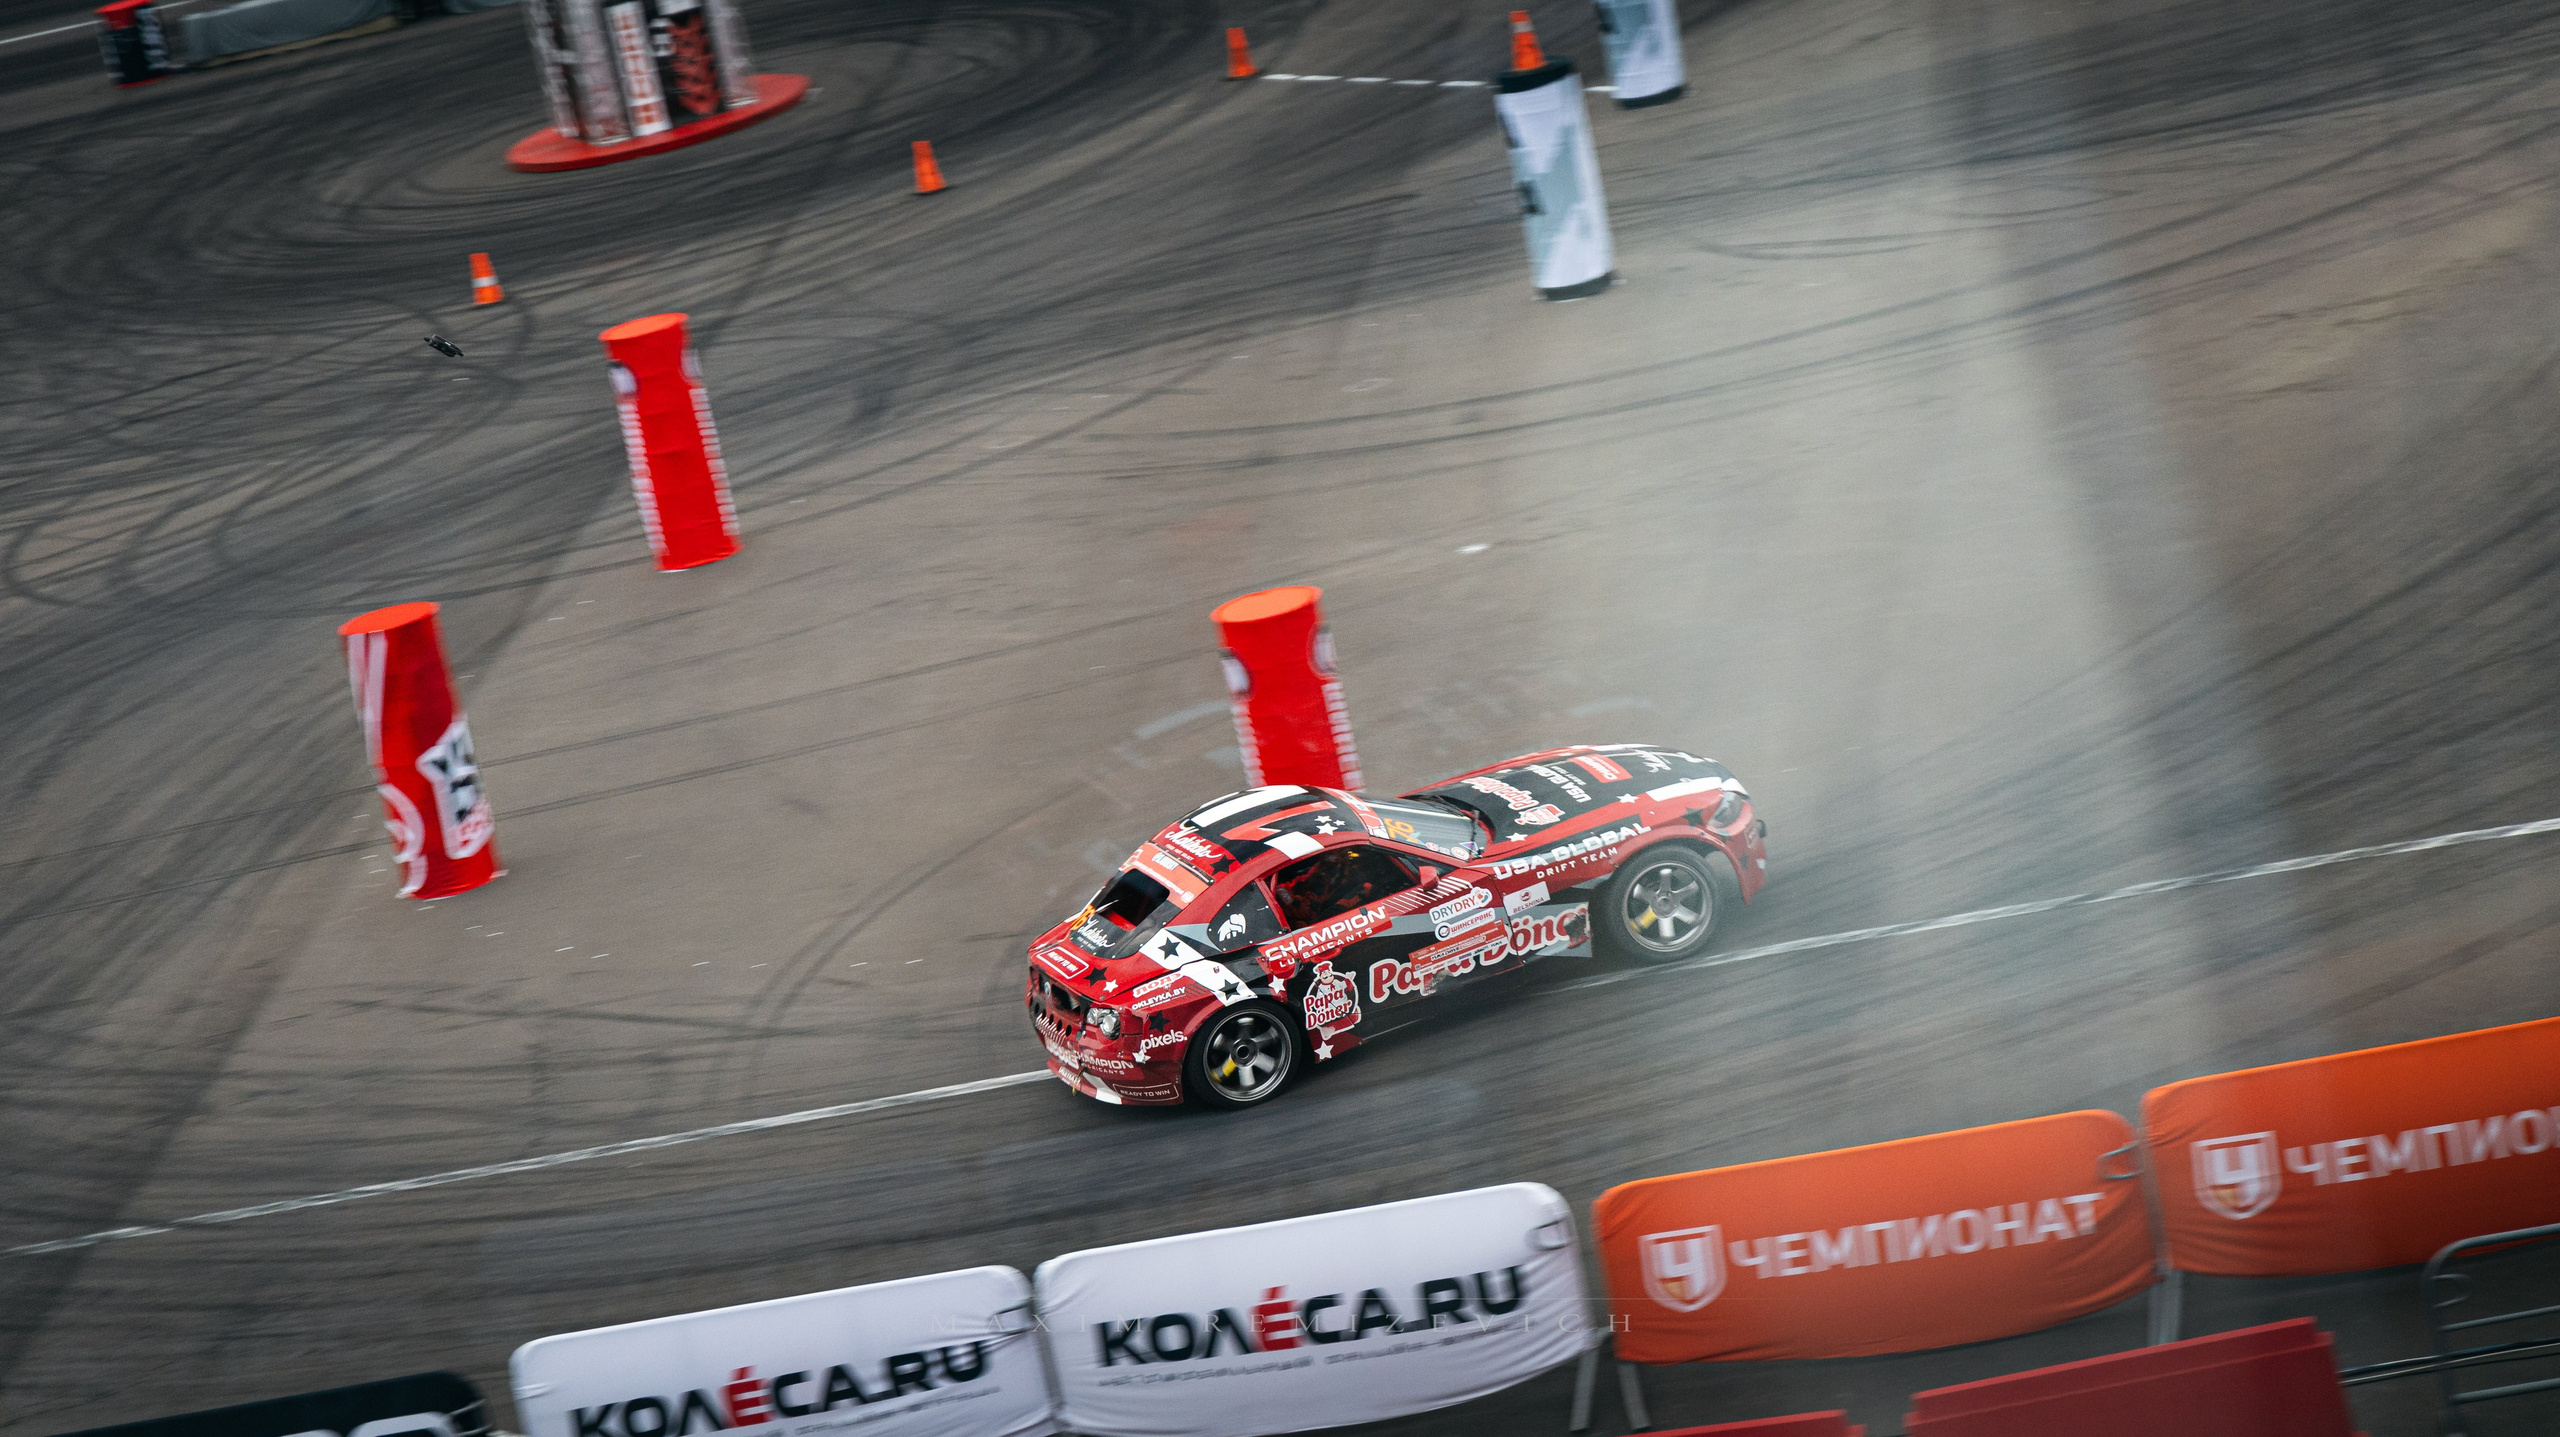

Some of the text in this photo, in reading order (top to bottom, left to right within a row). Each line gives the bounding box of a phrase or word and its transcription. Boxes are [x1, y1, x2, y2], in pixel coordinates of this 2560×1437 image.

[1493, 822, 1652, 880] USA GLOBAL
[1536, 846, 1619, 879] DRIFT TEAM
[1265, 905, 1387, 962] CHAMPION
[1279, 926, 1373, 968] LUBRICANTS
[1131, 986, 1187, 1011] OKLEYKA.BY
[1304, 986, 1345, 1014] Papa
[1305, 1000, 1353, 1030] Döner
[1140, 1029, 1189, 1054] pixels.
[1119, 1088, 1171, 1098] READY TO WIN
[2284, 1105, 2560, 1187] ЧЕМПИО
[1728, 1191, 2105, 1280] ЧЕМПИОНАТ
